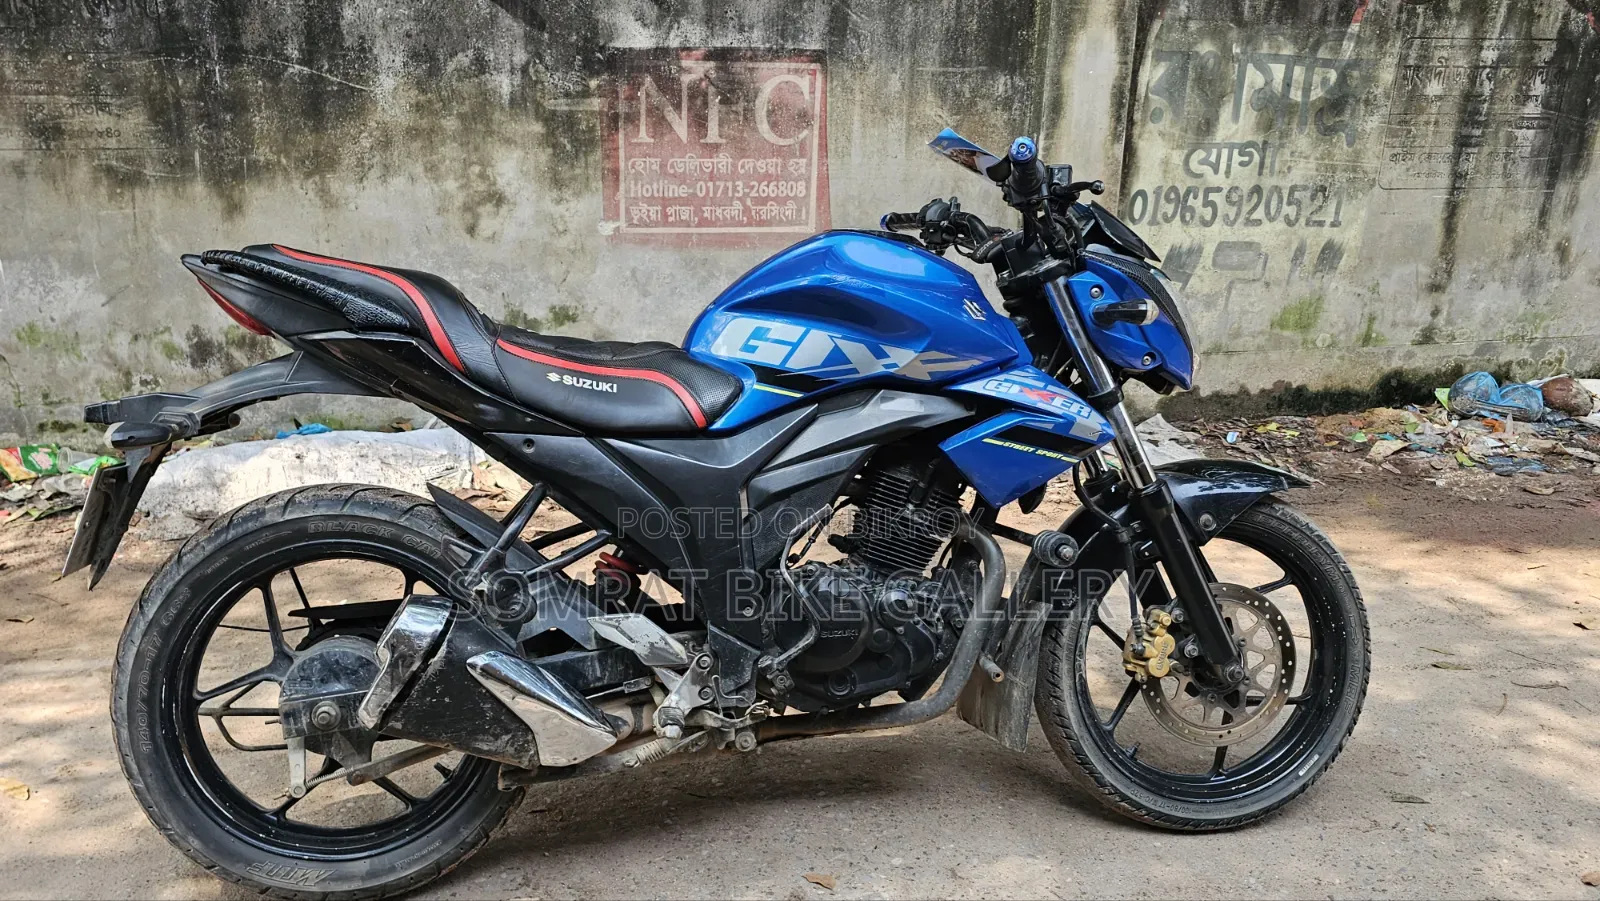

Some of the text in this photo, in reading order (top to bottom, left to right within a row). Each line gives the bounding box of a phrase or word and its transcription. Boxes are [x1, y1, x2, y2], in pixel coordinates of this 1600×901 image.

[628, 156, 661, 175] হোম
[1127, 184, 1344, 228] 01965920521
[562, 374, 617, 393] SUZUKI
[1003, 441, 1063, 460] STREET SPORT
[308, 520, 394, 539] BLACK
[820, 629, 859, 640] SUZUKI
[135, 631, 164, 753] 140/70-17
